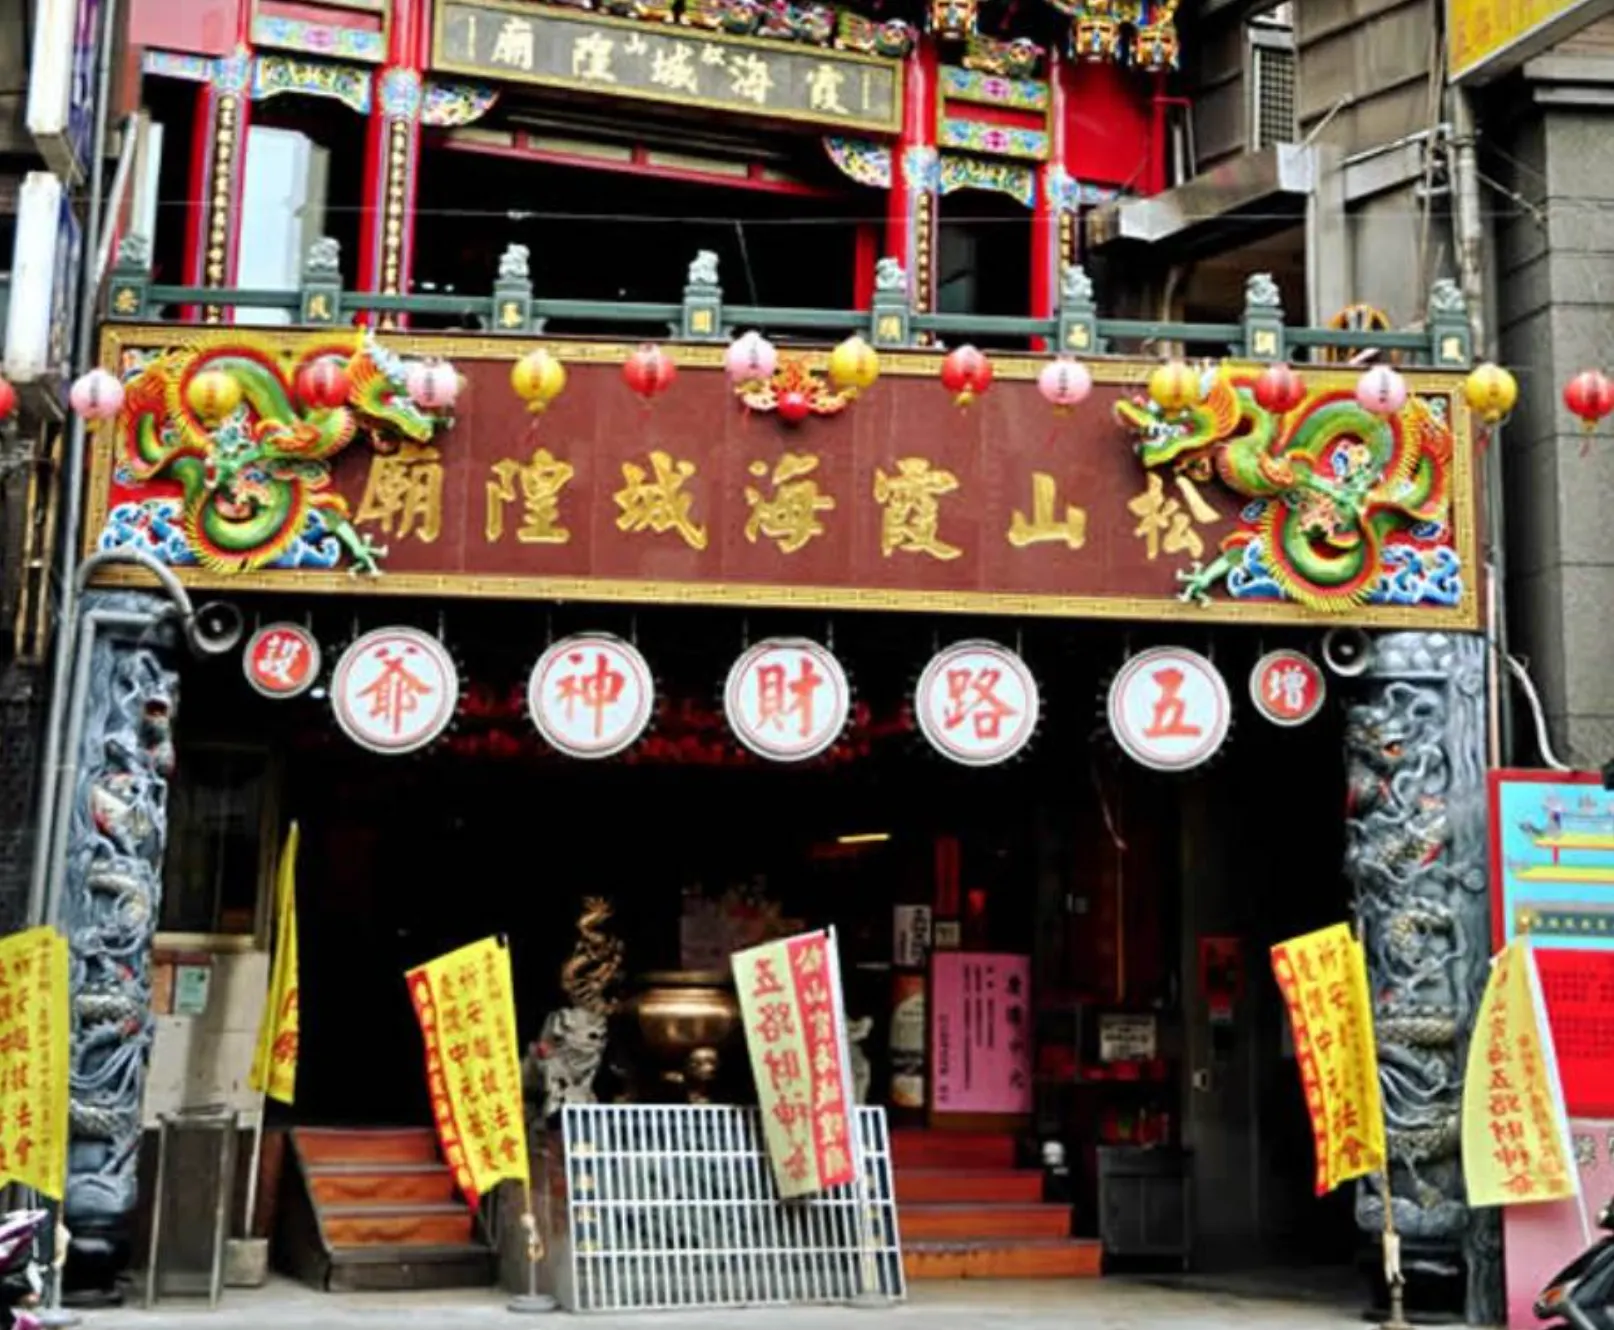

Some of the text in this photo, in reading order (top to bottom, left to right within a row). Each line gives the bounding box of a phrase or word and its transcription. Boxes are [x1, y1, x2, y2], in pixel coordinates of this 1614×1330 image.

[354, 445, 1220, 560] 松山霞海城隍廟
